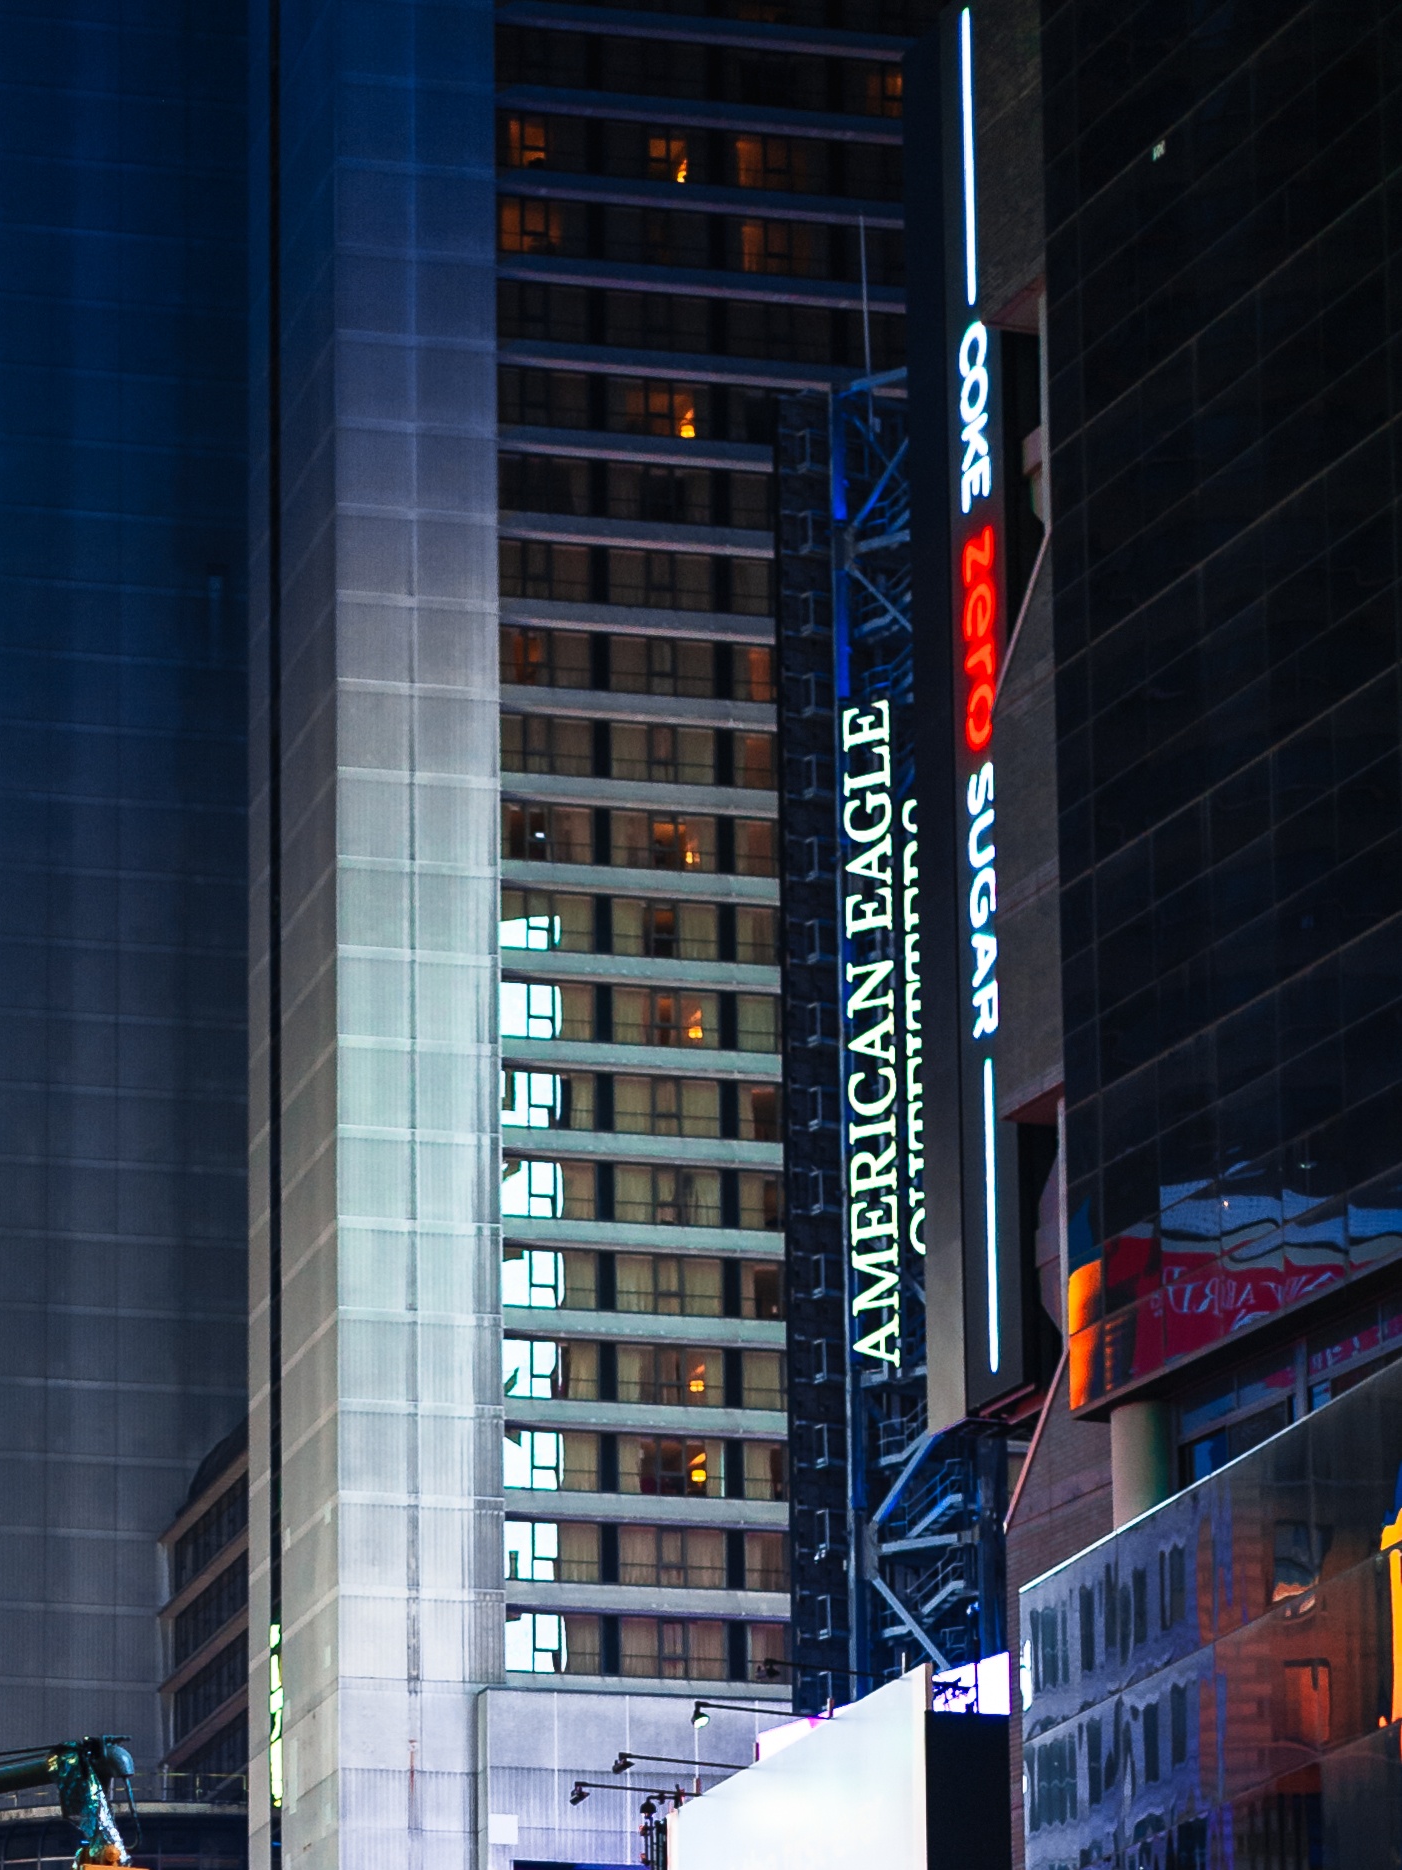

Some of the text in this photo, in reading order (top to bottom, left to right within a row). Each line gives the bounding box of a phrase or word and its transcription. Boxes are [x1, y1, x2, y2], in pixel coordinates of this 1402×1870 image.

[958, 320, 999, 1040] COKE zero SUGAR
[842, 698, 900, 1367] AMERICAN EAGLE
